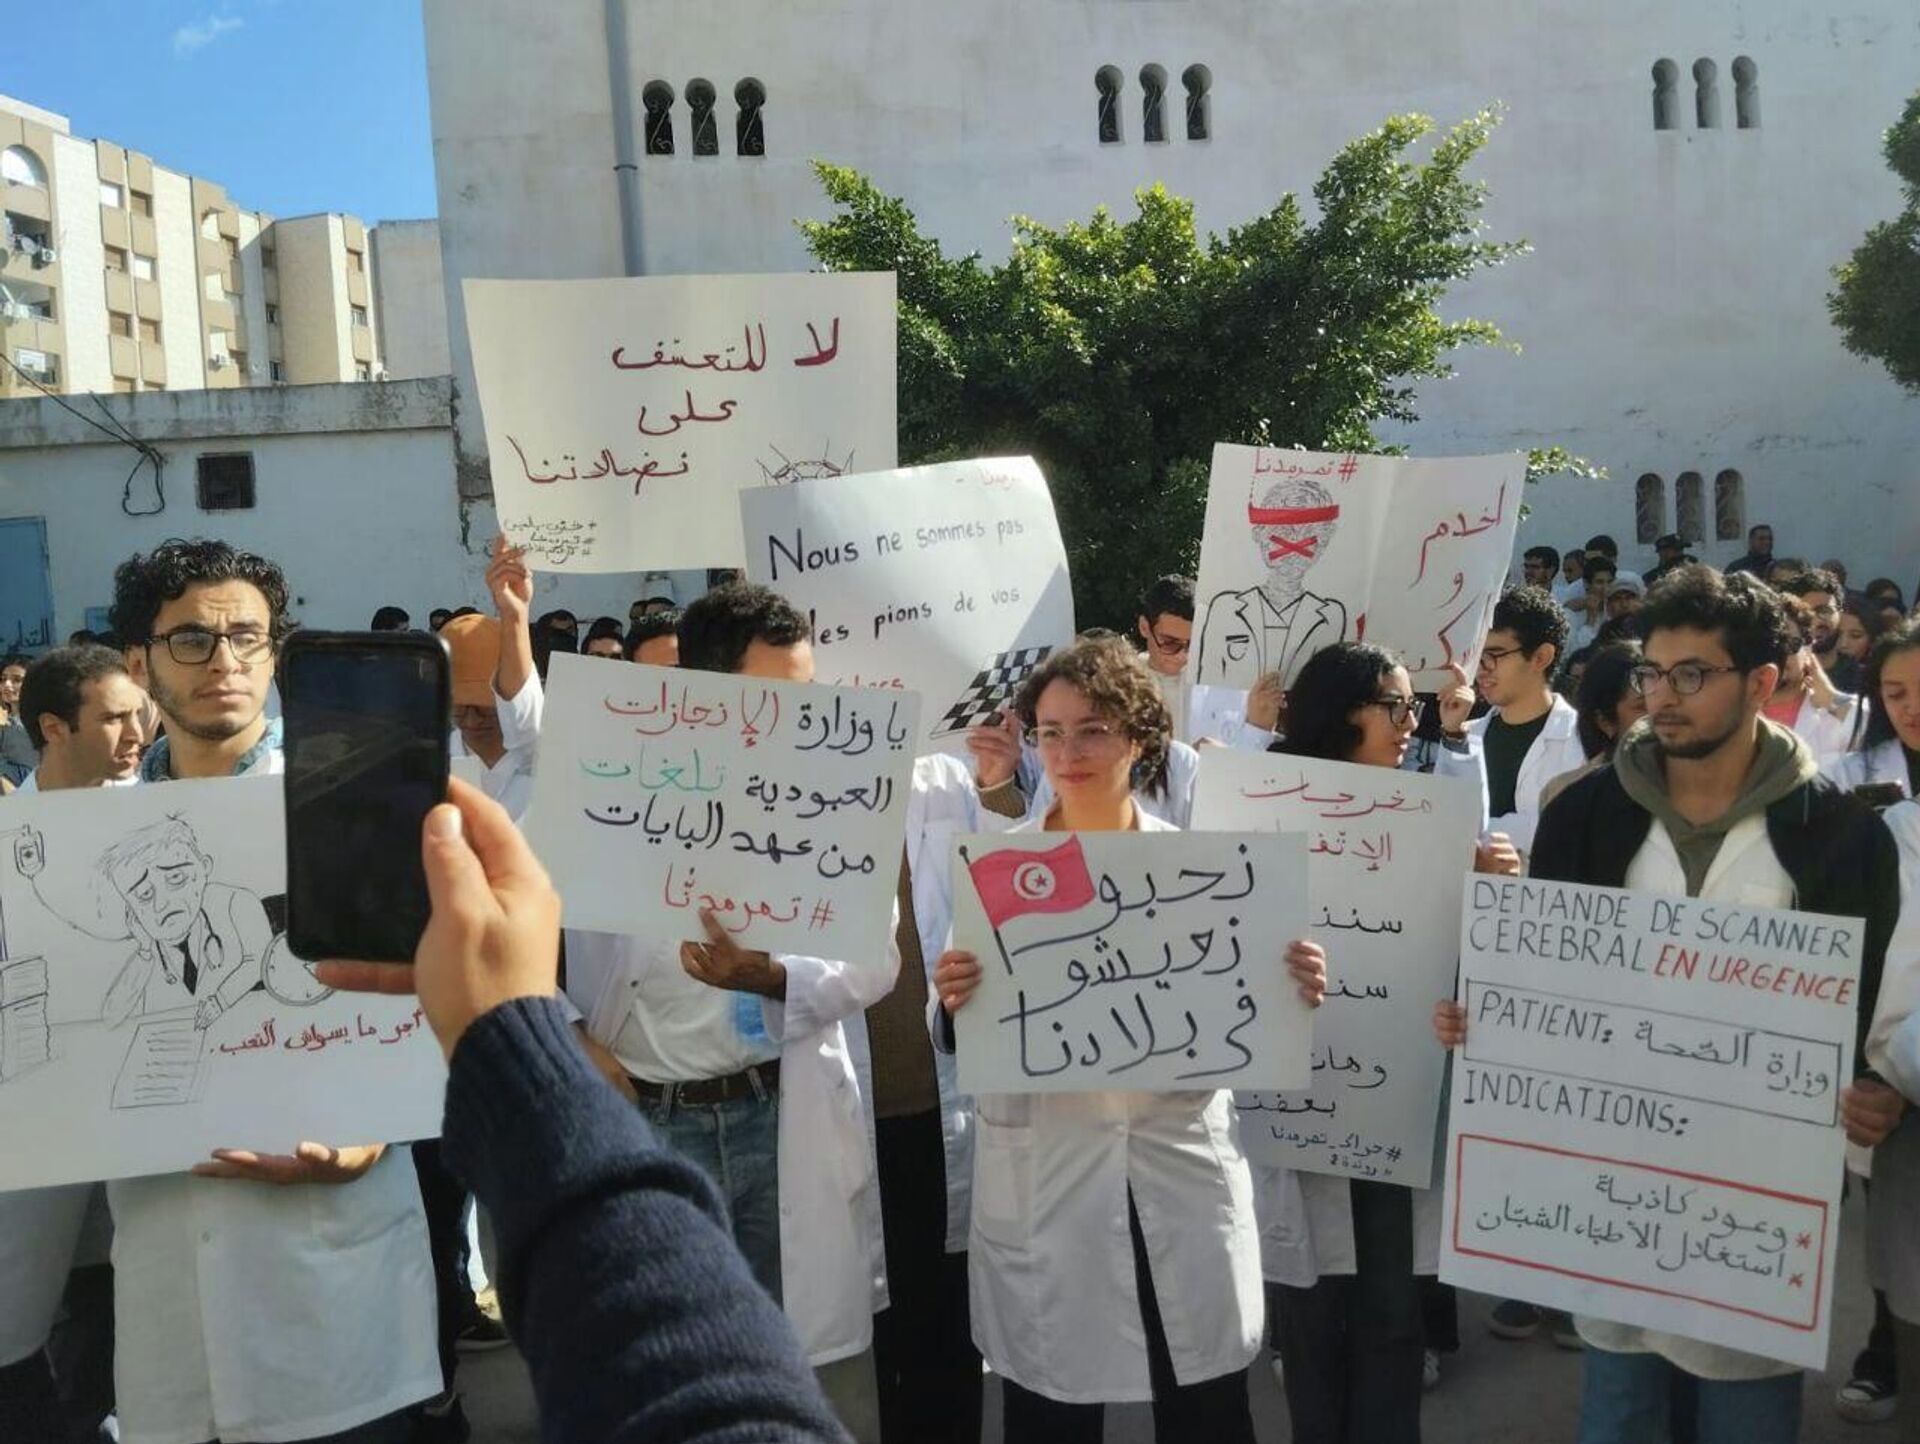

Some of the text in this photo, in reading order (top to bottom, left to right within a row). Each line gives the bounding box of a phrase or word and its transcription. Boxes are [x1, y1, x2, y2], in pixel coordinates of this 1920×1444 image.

[795, 317, 839, 367] لا
[638, 389, 738, 436] على
[767, 519, 1025, 581] Nous ne sommes pas
[808, 588, 1021, 648] les pions de vos
[796, 695, 875, 756] وزارة
[744, 775, 894, 818] العبودية
[583, 793, 876, 879] من عهد البايات
[1010, 843, 1255, 957] نحبو
[1472, 879, 1852, 960] DEMANDE DE SCANNER
[1469, 916, 1857, 1006] CEREBRAL EN URGENCE
[356, 1013, 377, 1037] ما
[1017, 989, 1199, 1077] بلادنا
[1478, 989, 1614, 1044] PATIENT:
[1463, 1069, 1691, 1137] INDICATIONS:
[1766, 1051, 1830, 1099] وزارة
[1595, 1173, 1789, 1254] وعود كاذبة
